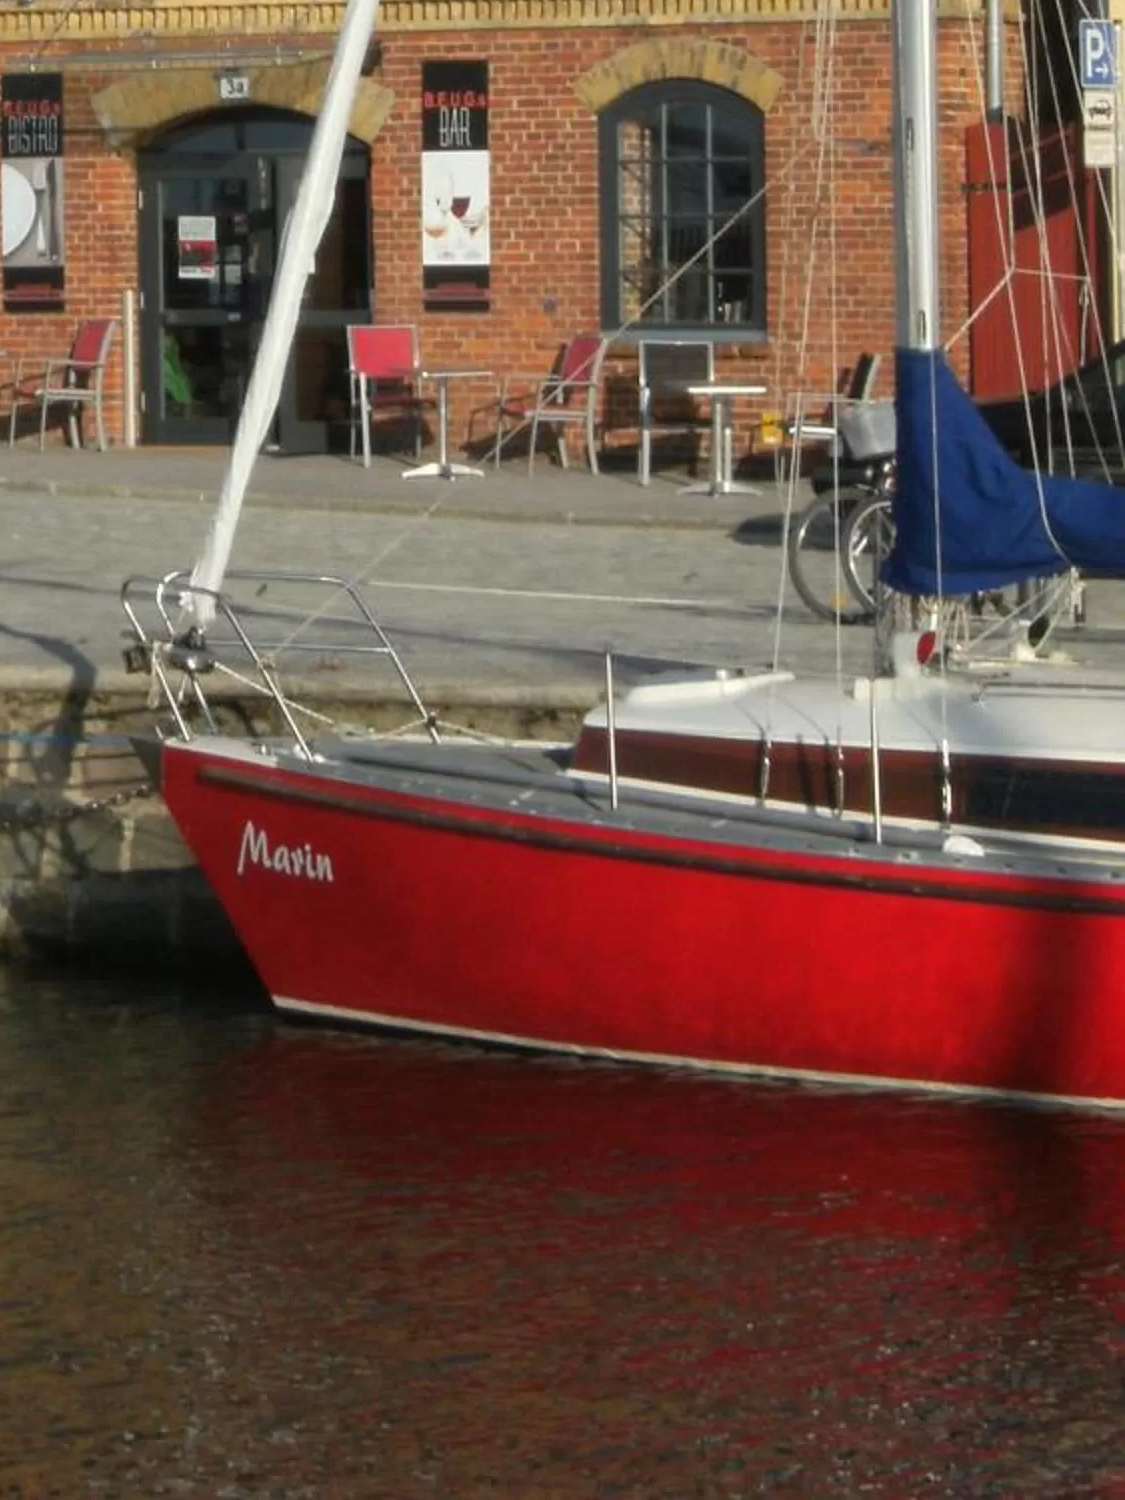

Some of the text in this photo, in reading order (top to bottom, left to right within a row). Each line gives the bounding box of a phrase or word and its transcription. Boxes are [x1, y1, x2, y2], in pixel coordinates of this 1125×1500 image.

[1086, 28, 1104, 78] P
[8, 115, 57, 153] BISTRO
[439, 106, 472, 148] BAR
[237, 820, 333, 882] Marin
